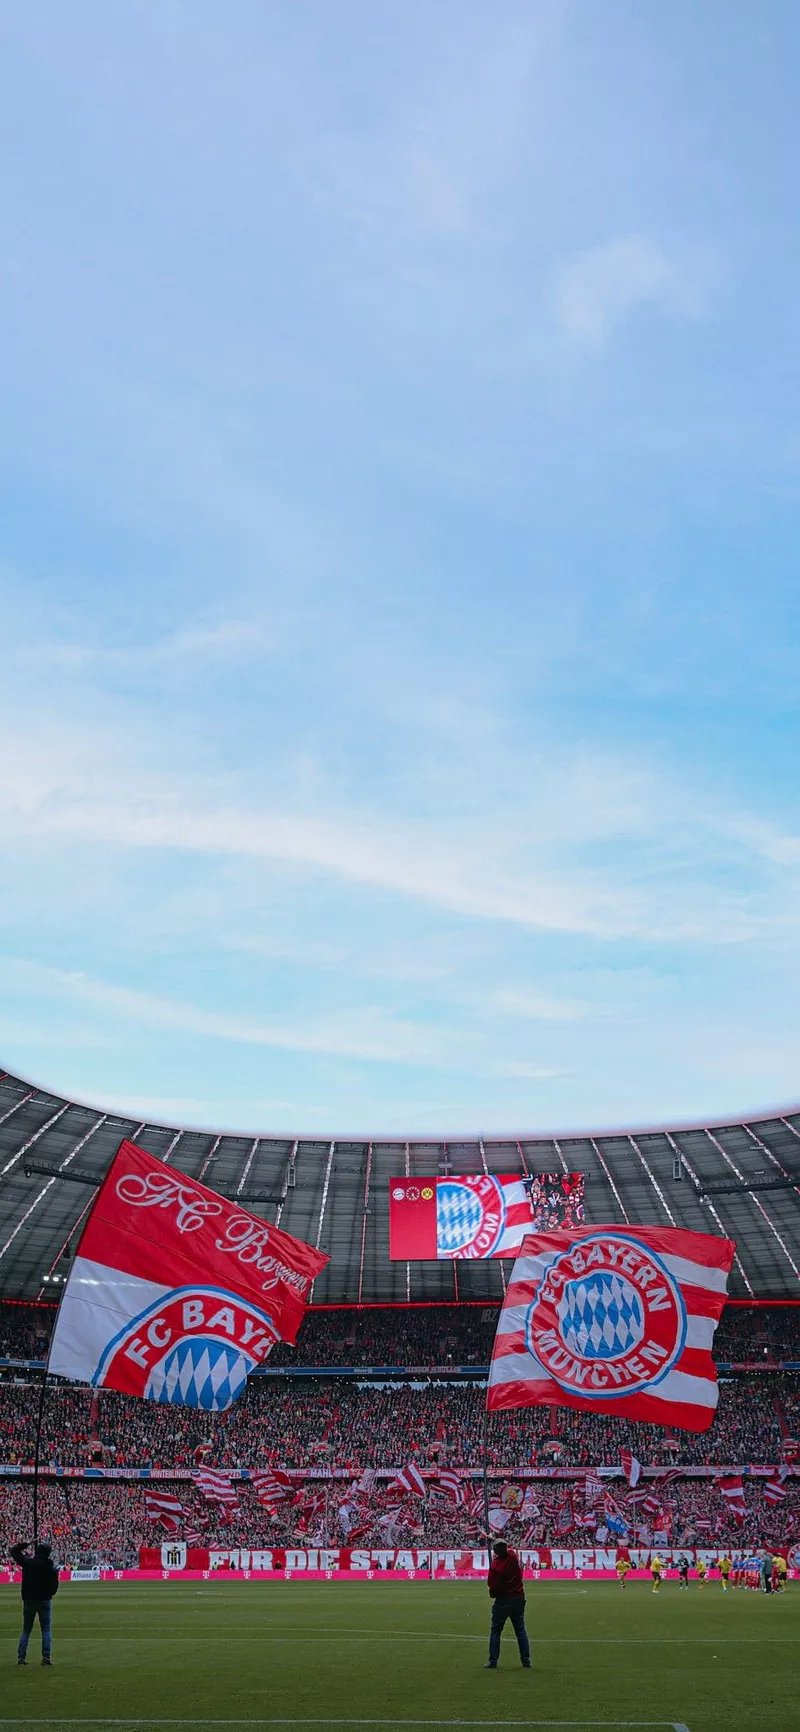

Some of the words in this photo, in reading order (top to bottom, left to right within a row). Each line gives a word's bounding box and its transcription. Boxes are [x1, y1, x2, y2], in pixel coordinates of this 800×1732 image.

[116, 1172, 222, 1234] FC
[541, 1269, 567, 1304] FC
[570, 1244, 673, 1313] BAYERN
[123, 1318, 172, 1370] FC
[534, 1328, 669, 1388] MÜNCHEN
[72, 1571, 91, 1579] Allianz
[209, 1548, 274, 1570] FÜR
[284, 1550, 340, 1570] DIE
[550, 1549, 618, 1570] DEN
